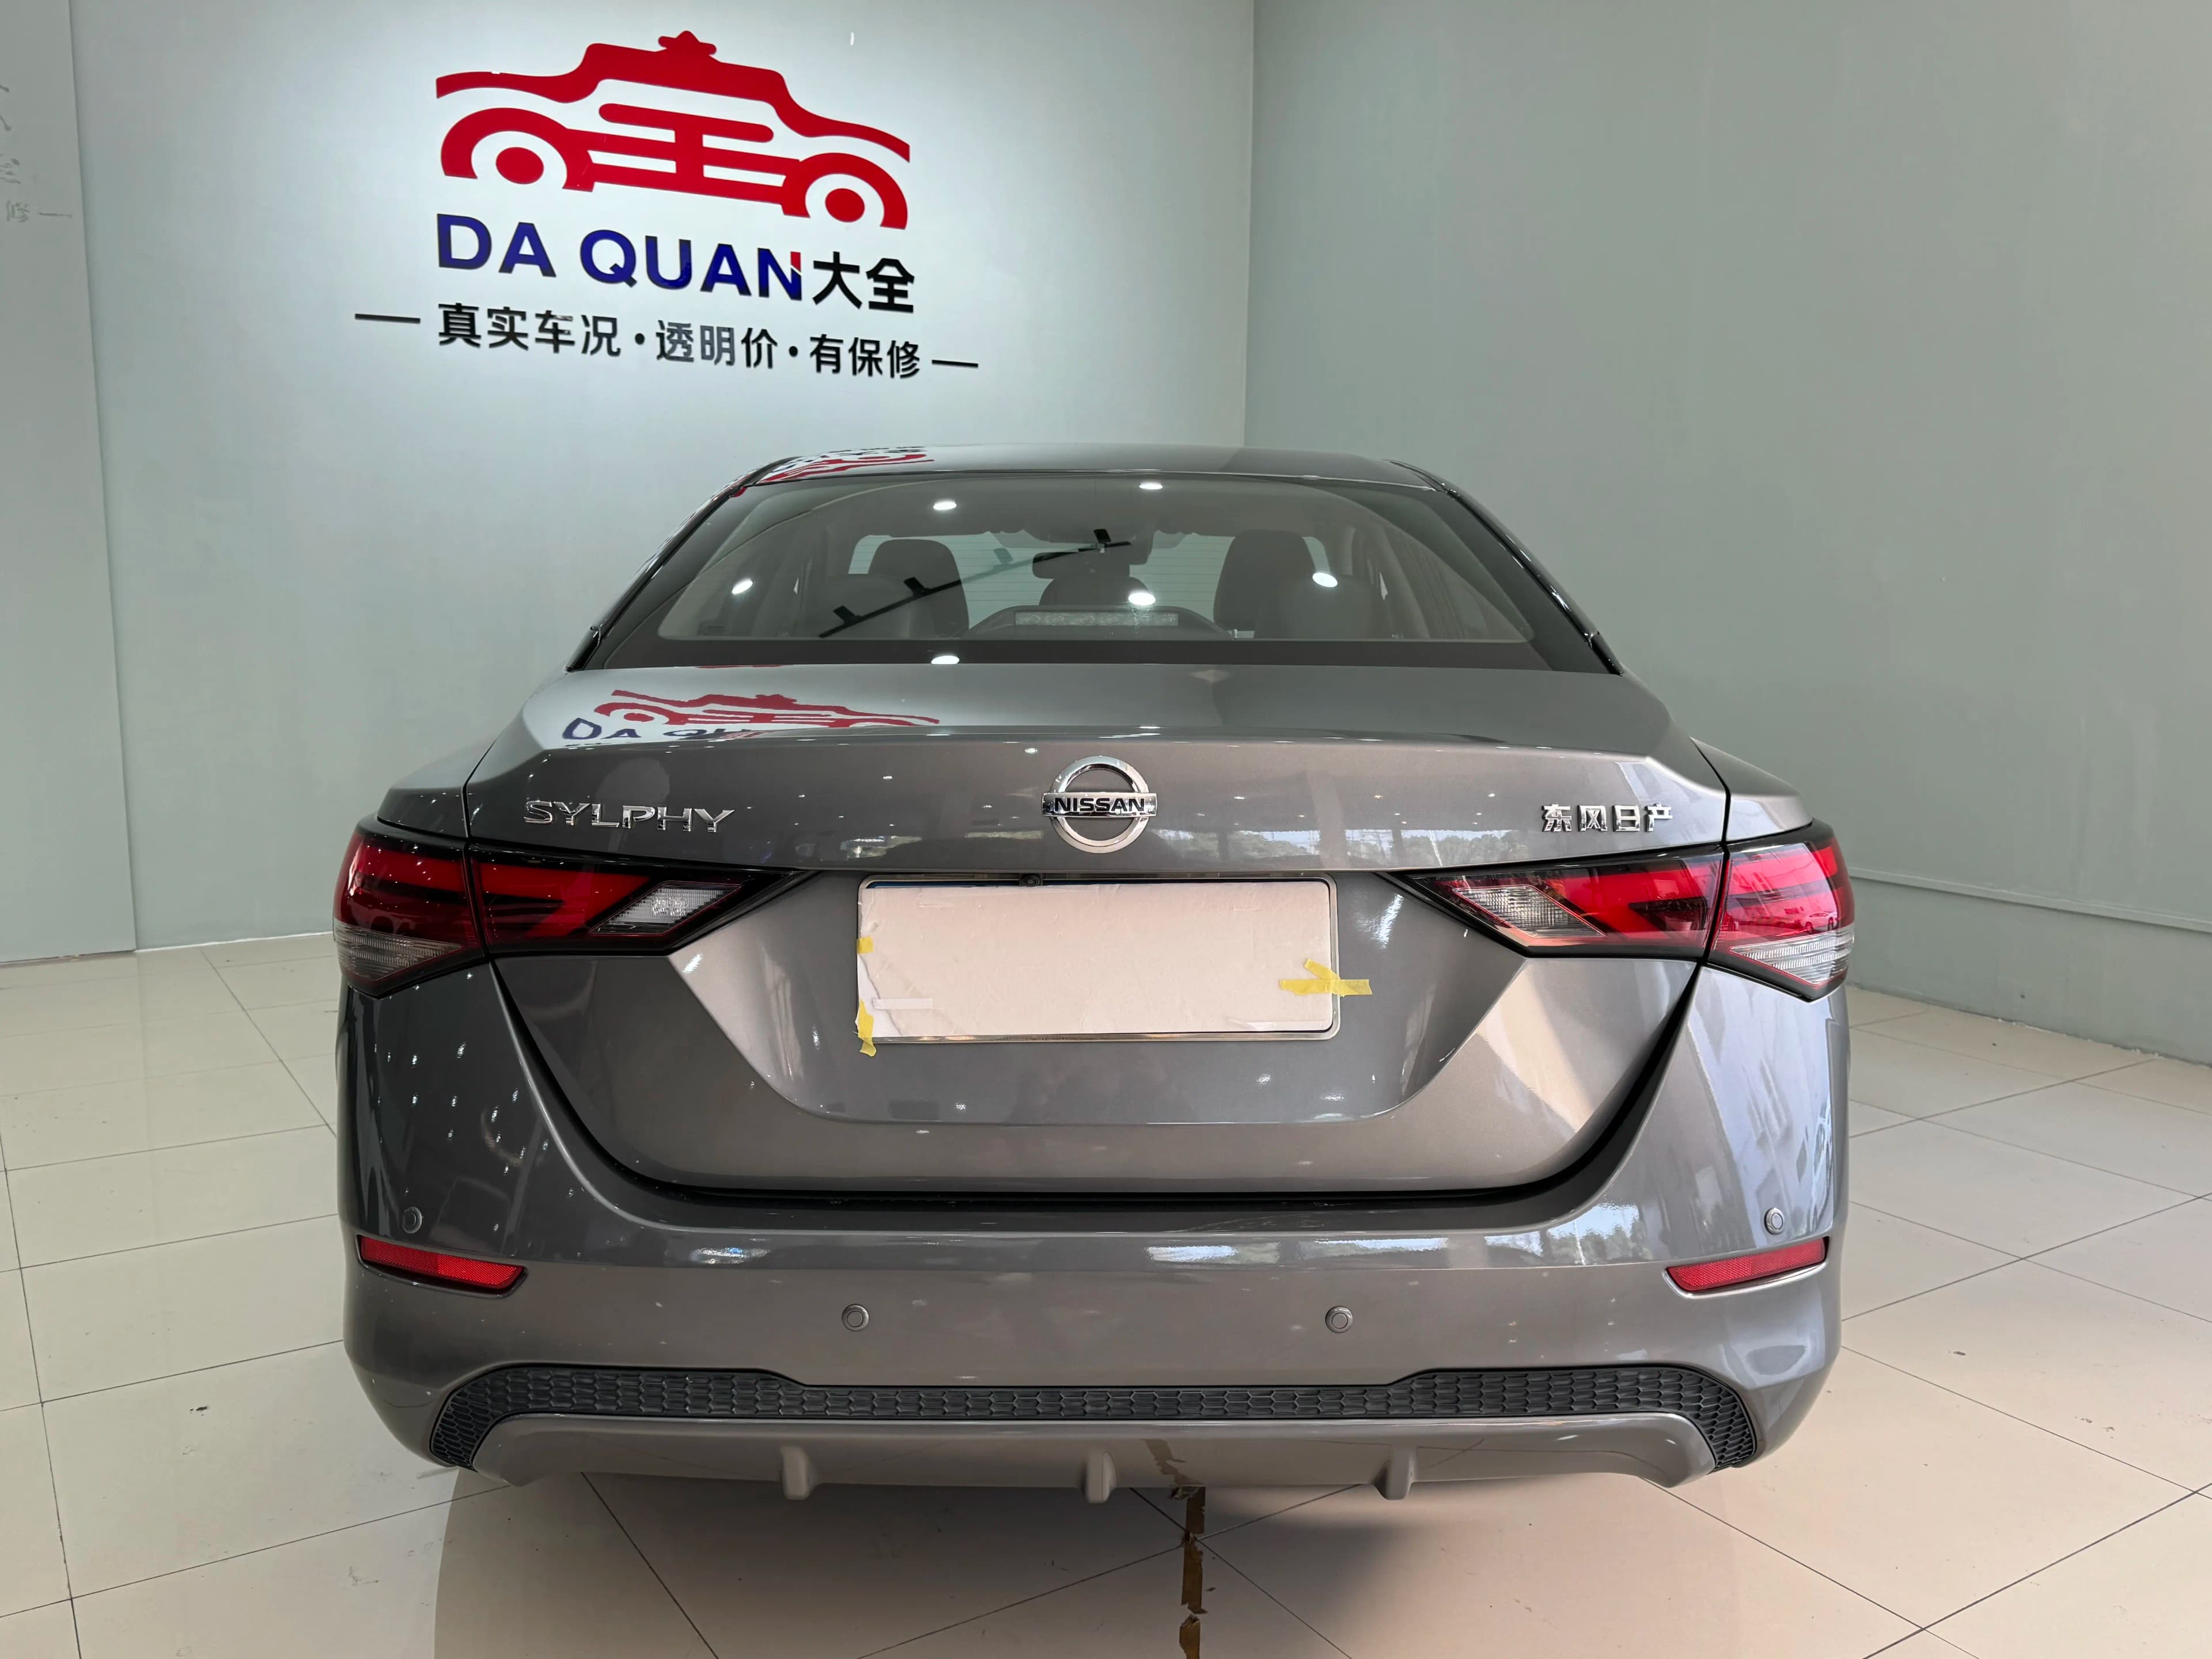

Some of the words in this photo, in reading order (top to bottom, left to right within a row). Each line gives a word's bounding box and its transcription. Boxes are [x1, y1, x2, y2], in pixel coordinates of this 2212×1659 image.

[437, 213, 556, 278] DA
[524, 801, 735, 832] SYLPHY
[1054, 798, 1145, 812] NISSAN
[1541, 803, 1673, 832] 东风日产
